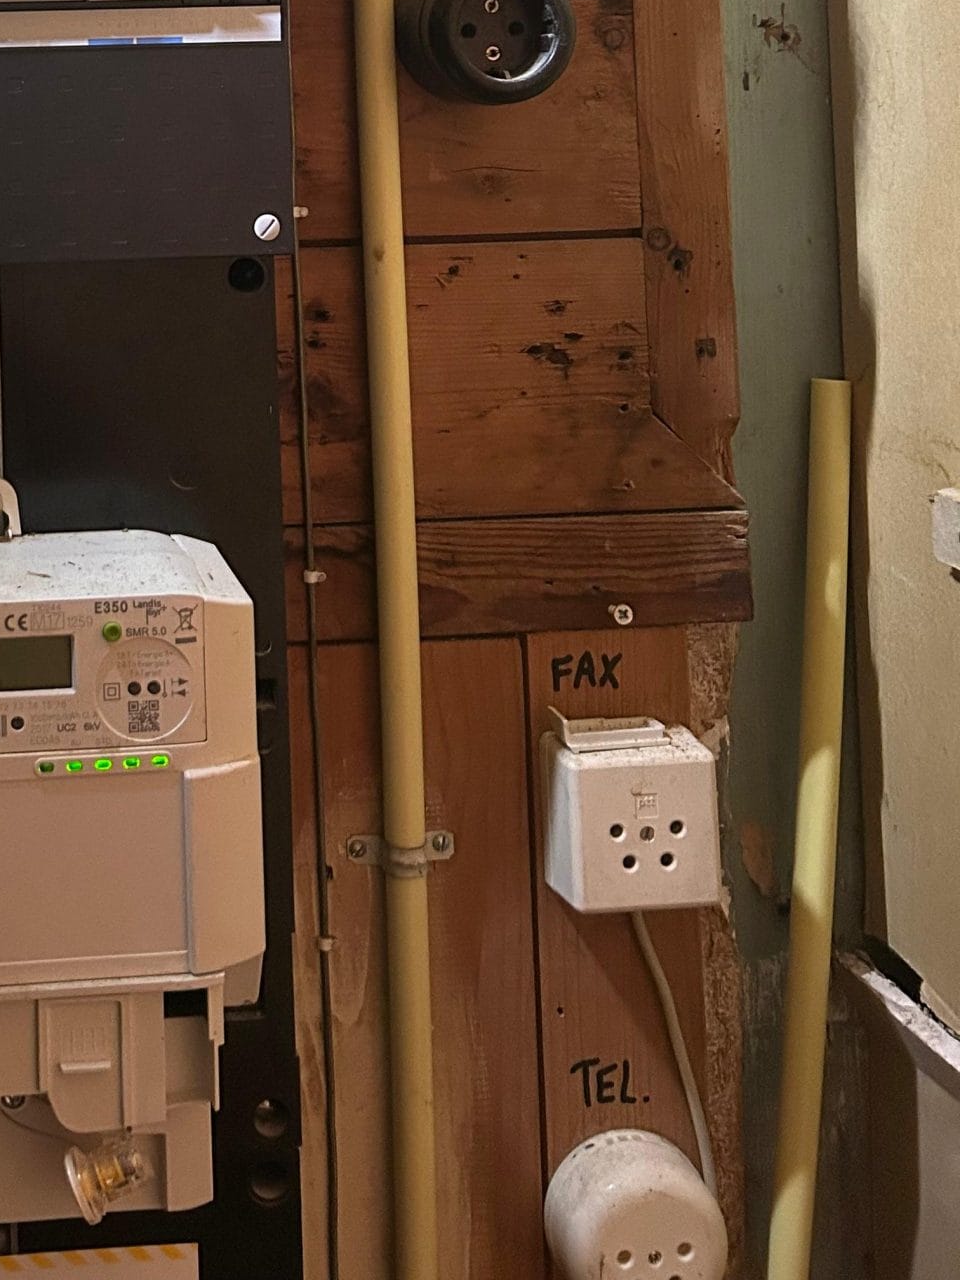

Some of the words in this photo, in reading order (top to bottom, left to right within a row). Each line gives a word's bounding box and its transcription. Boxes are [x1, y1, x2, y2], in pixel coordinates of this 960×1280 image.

[94, 601, 128, 615] E350
[133, 599, 161, 609] Landis
[126, 627, 149, 638] SMR
[151, 627, 167, 636] 5.0
[551, 650, 623, 692] FAX
[57, 723, 77, 732] UC2
[83, 722, 101, 731] 6kV
[570, 1057, 650, 1108] TEL.
